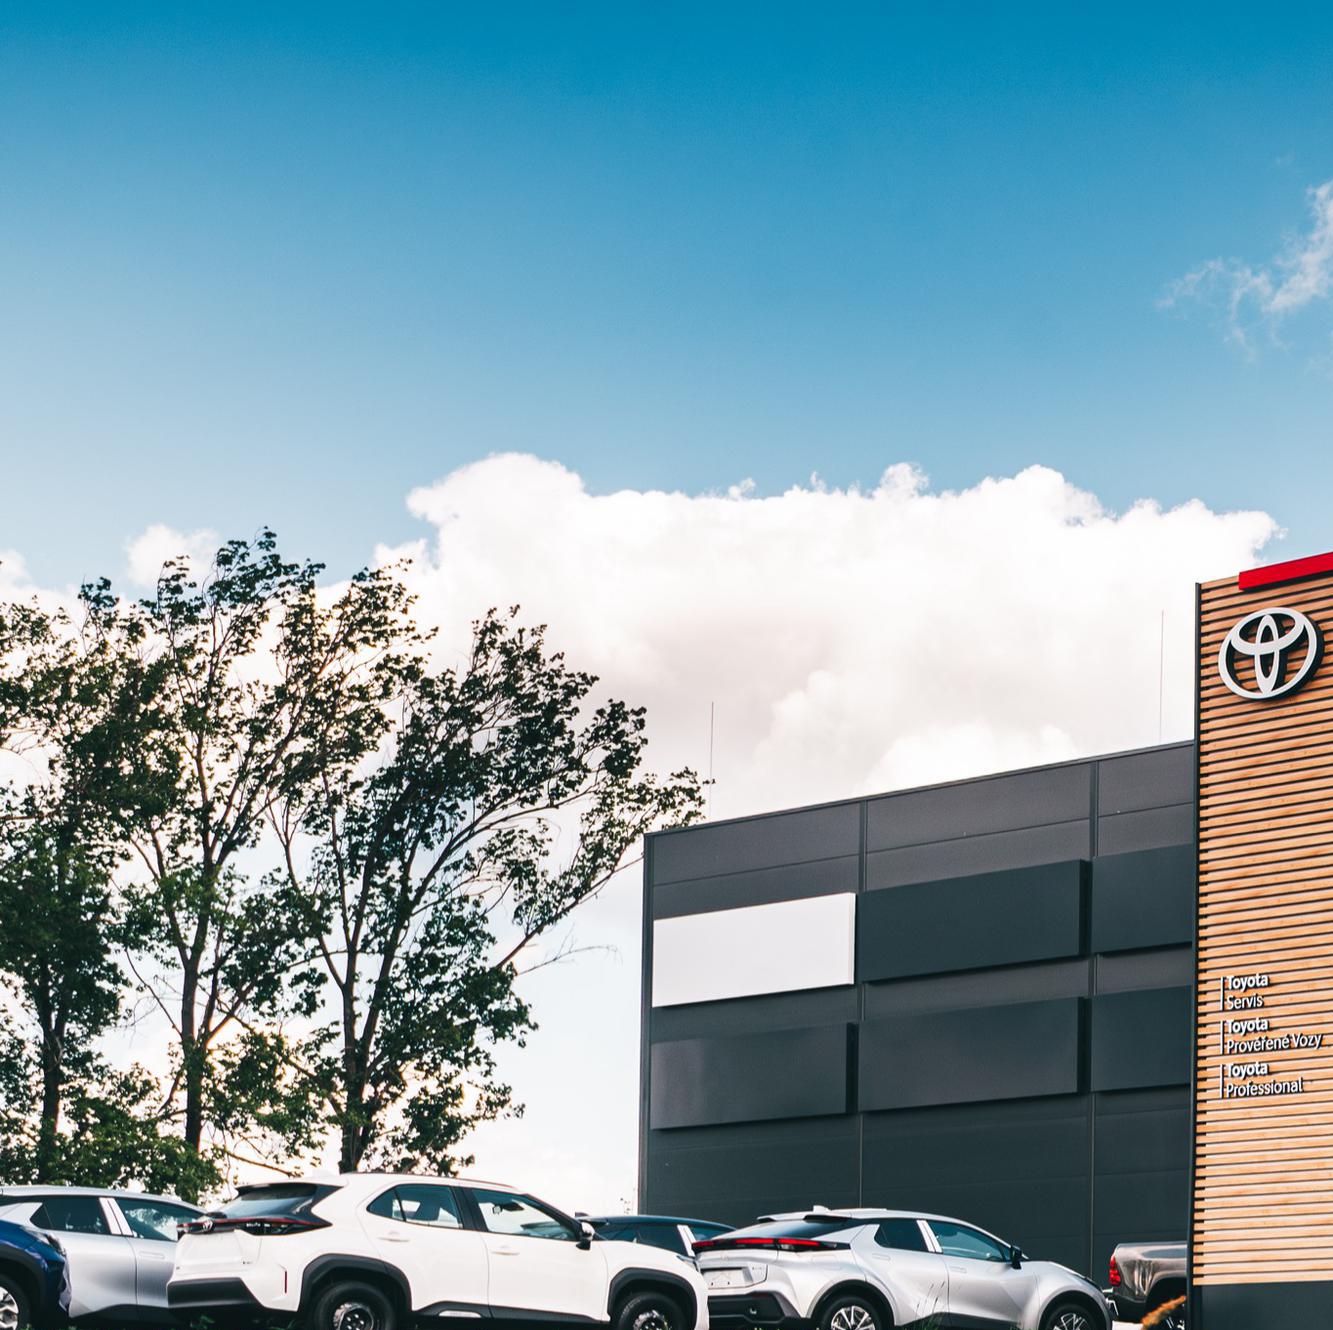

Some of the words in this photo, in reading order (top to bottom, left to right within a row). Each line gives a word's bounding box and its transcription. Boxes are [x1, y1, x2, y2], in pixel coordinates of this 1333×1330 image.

[1227, 973, 1269, 992] Toyota
[1226, 994, 1264, 1011] Servis
[1227, 1017, 1269, 1036] Toyota
[1291, 1033, 1323, 1050] Vozy
[1227, 1061, 1269, 1080] Toyota
[1226, 1078, 1303, 1098] Professional
